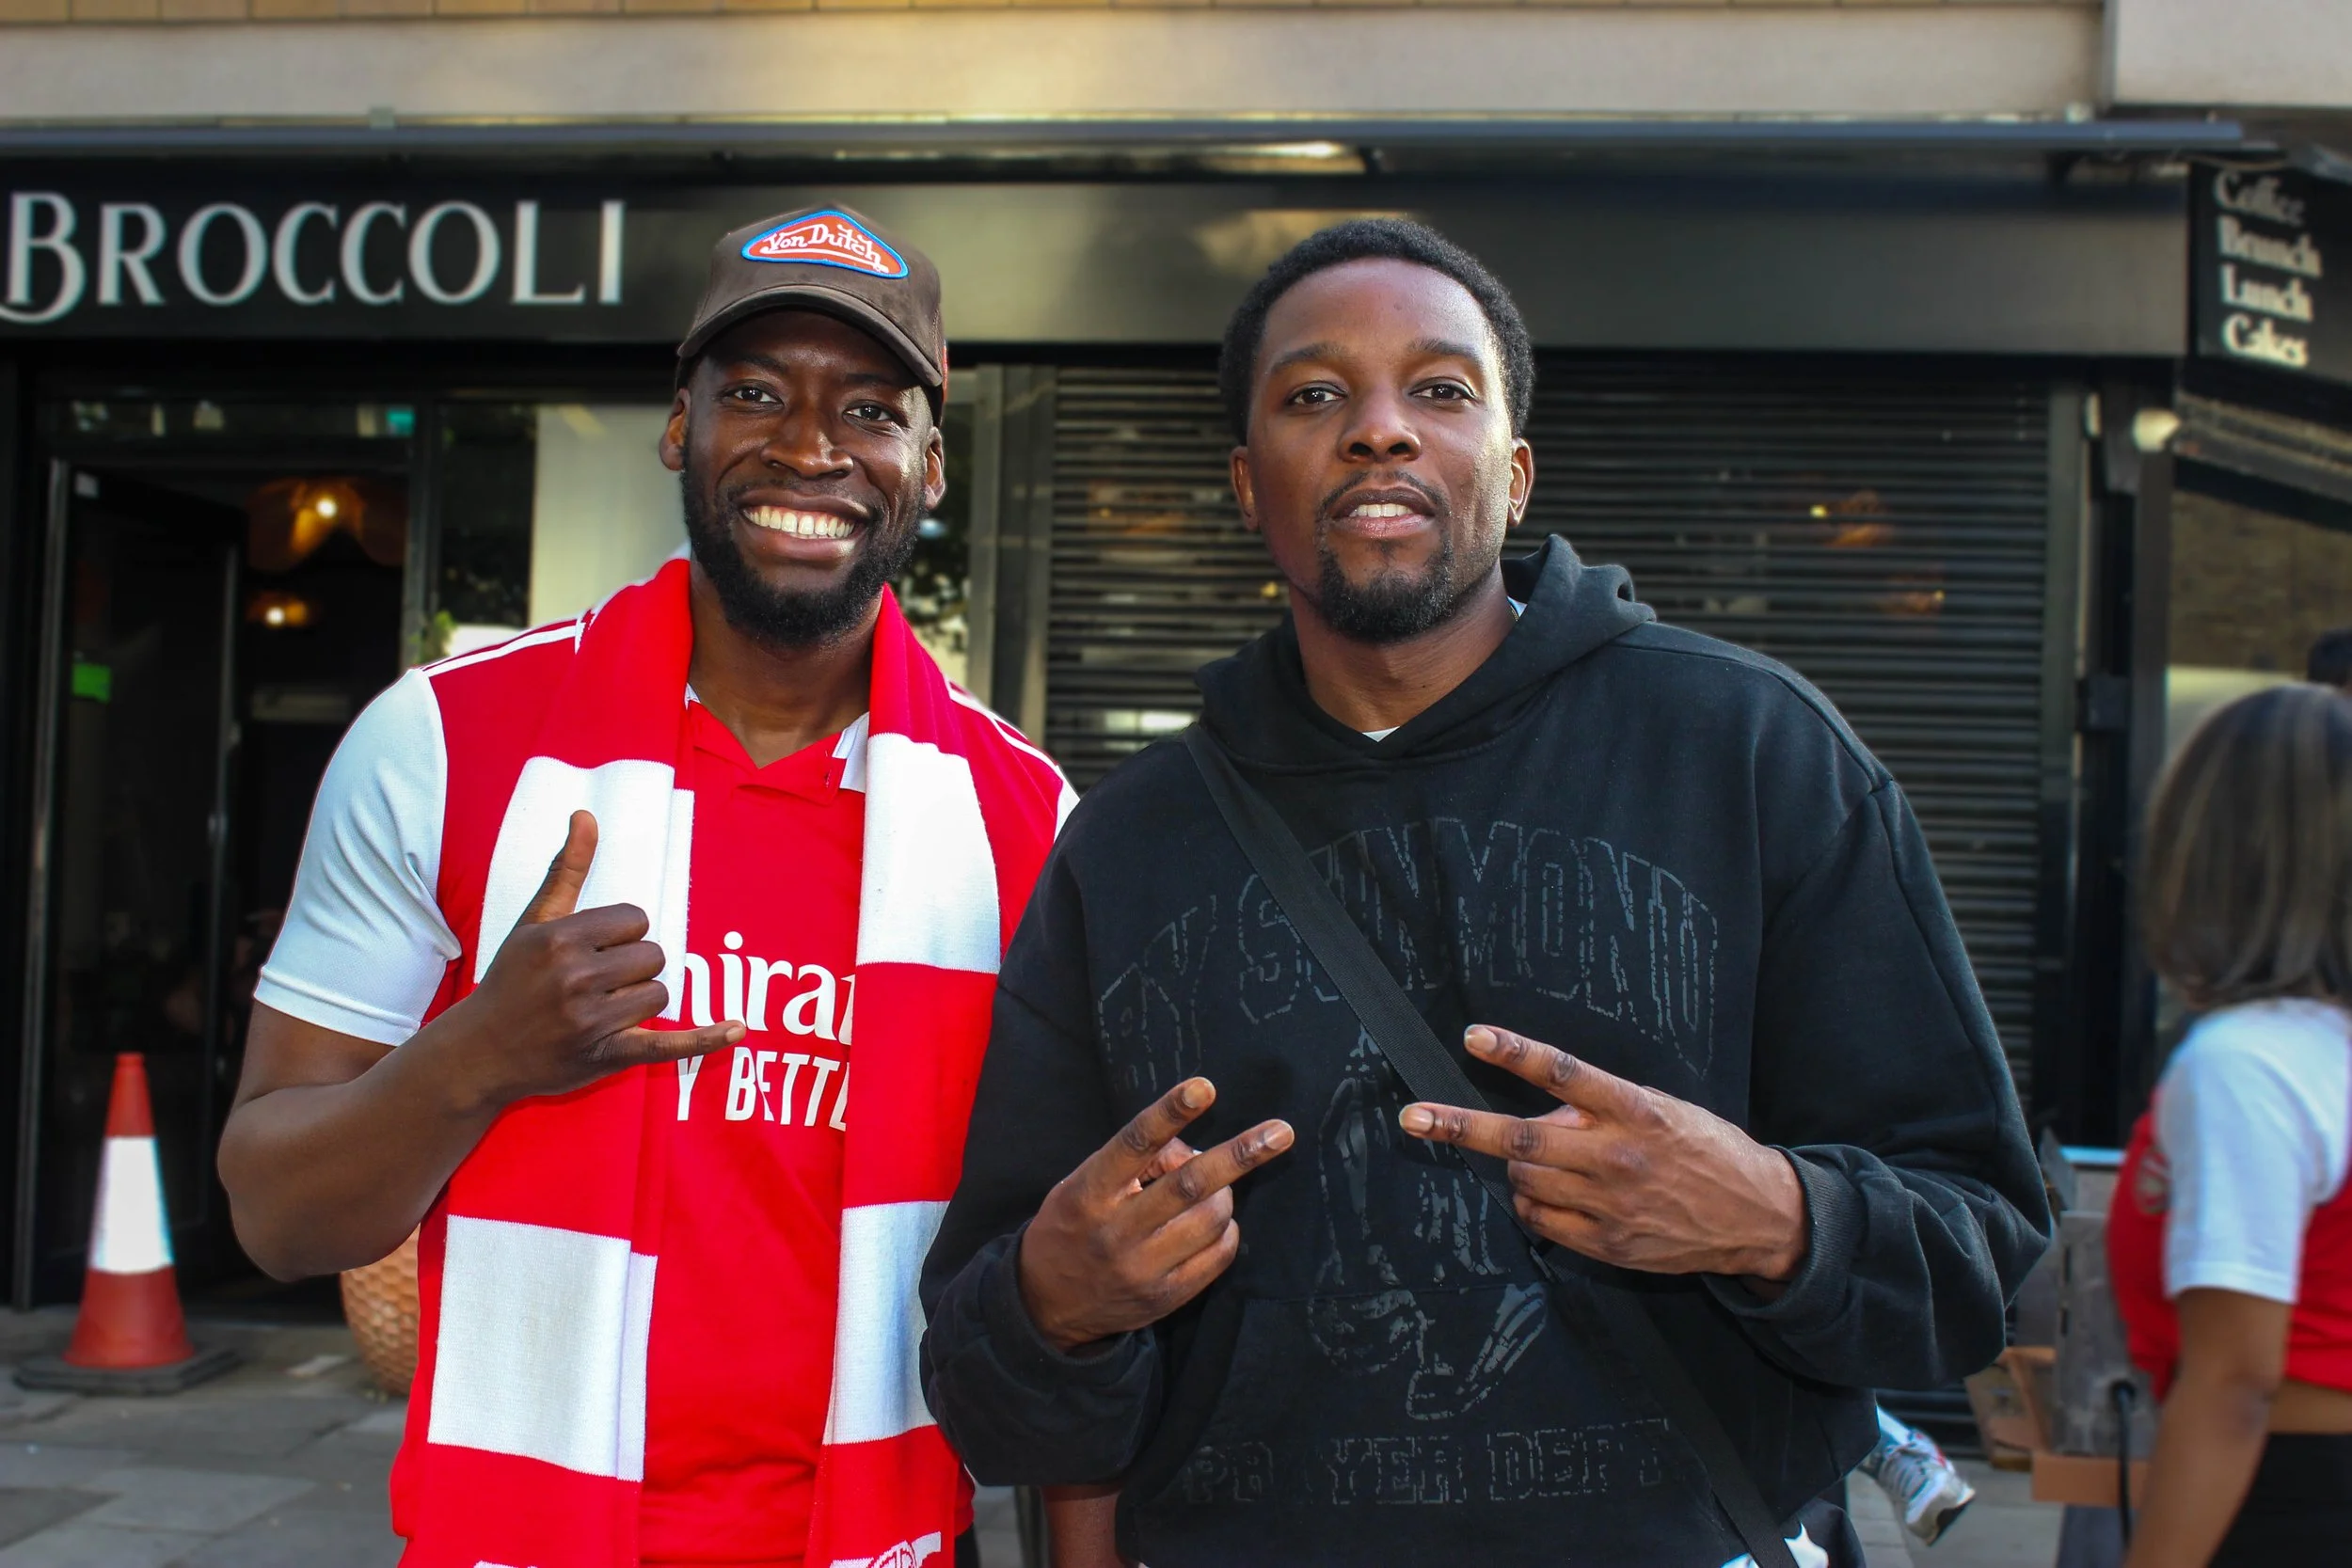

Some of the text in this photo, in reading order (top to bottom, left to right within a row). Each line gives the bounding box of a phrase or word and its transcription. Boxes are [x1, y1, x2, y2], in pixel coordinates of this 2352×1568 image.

[0, 193, 626, 324] BROCCOLI
[760, 223, 889, 273] Von Dutch
[2220, 262, 2312, 324] Lunch
[2222, 312, 2308, 369] Cakes
